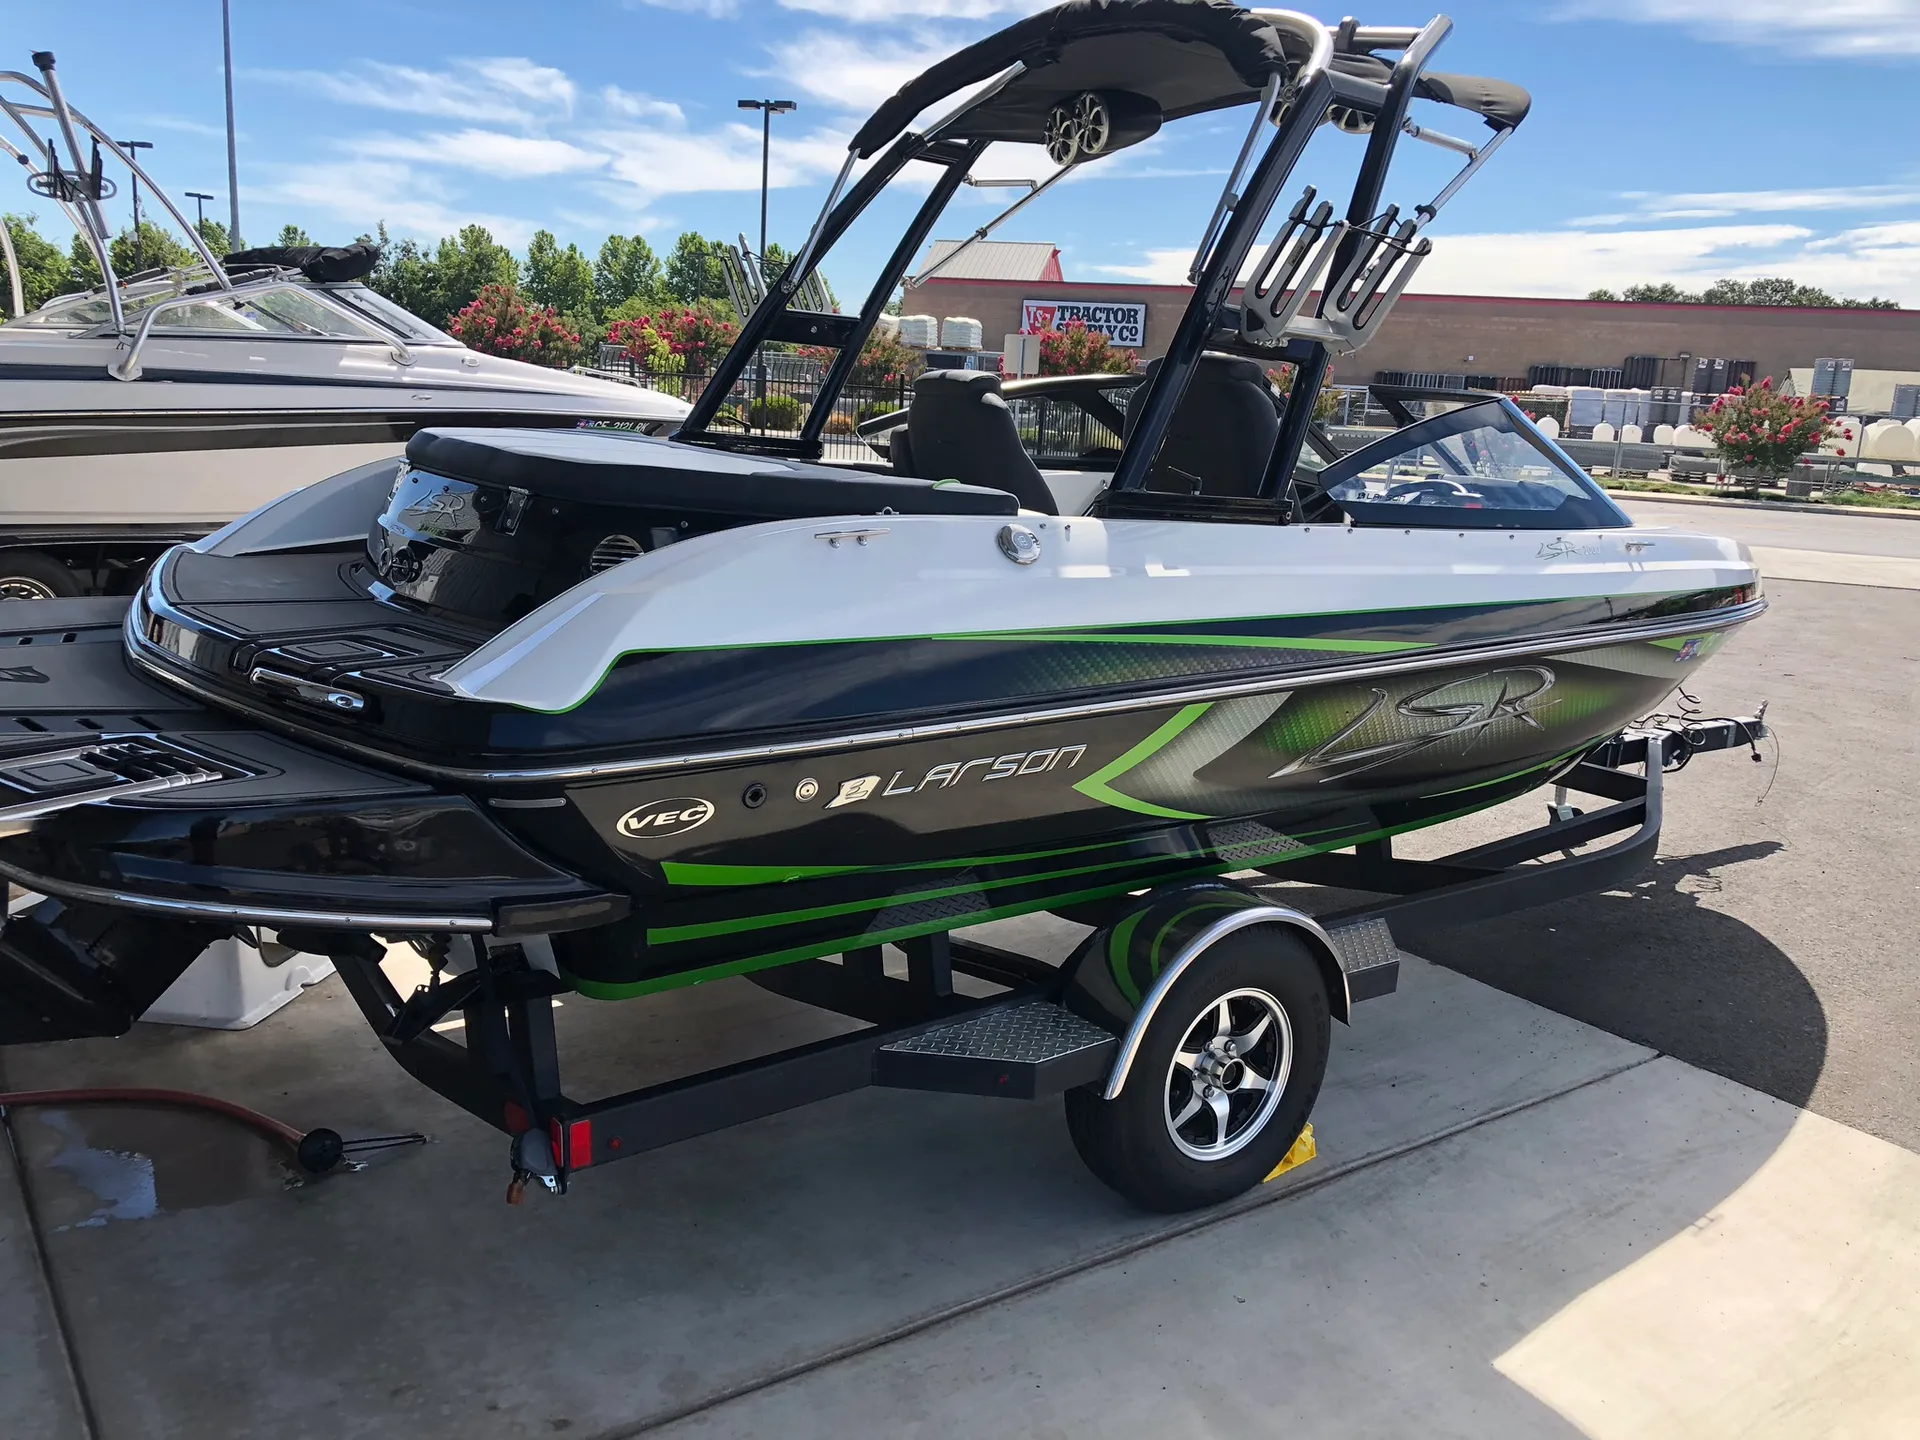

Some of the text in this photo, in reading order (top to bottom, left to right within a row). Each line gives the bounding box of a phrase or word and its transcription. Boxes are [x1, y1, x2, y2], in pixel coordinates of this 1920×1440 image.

[1057, 305, 1138, 325] TRACTOR
[881, 743, 1087, 796] LARSON
[627, 806, 708, 831] VEC
